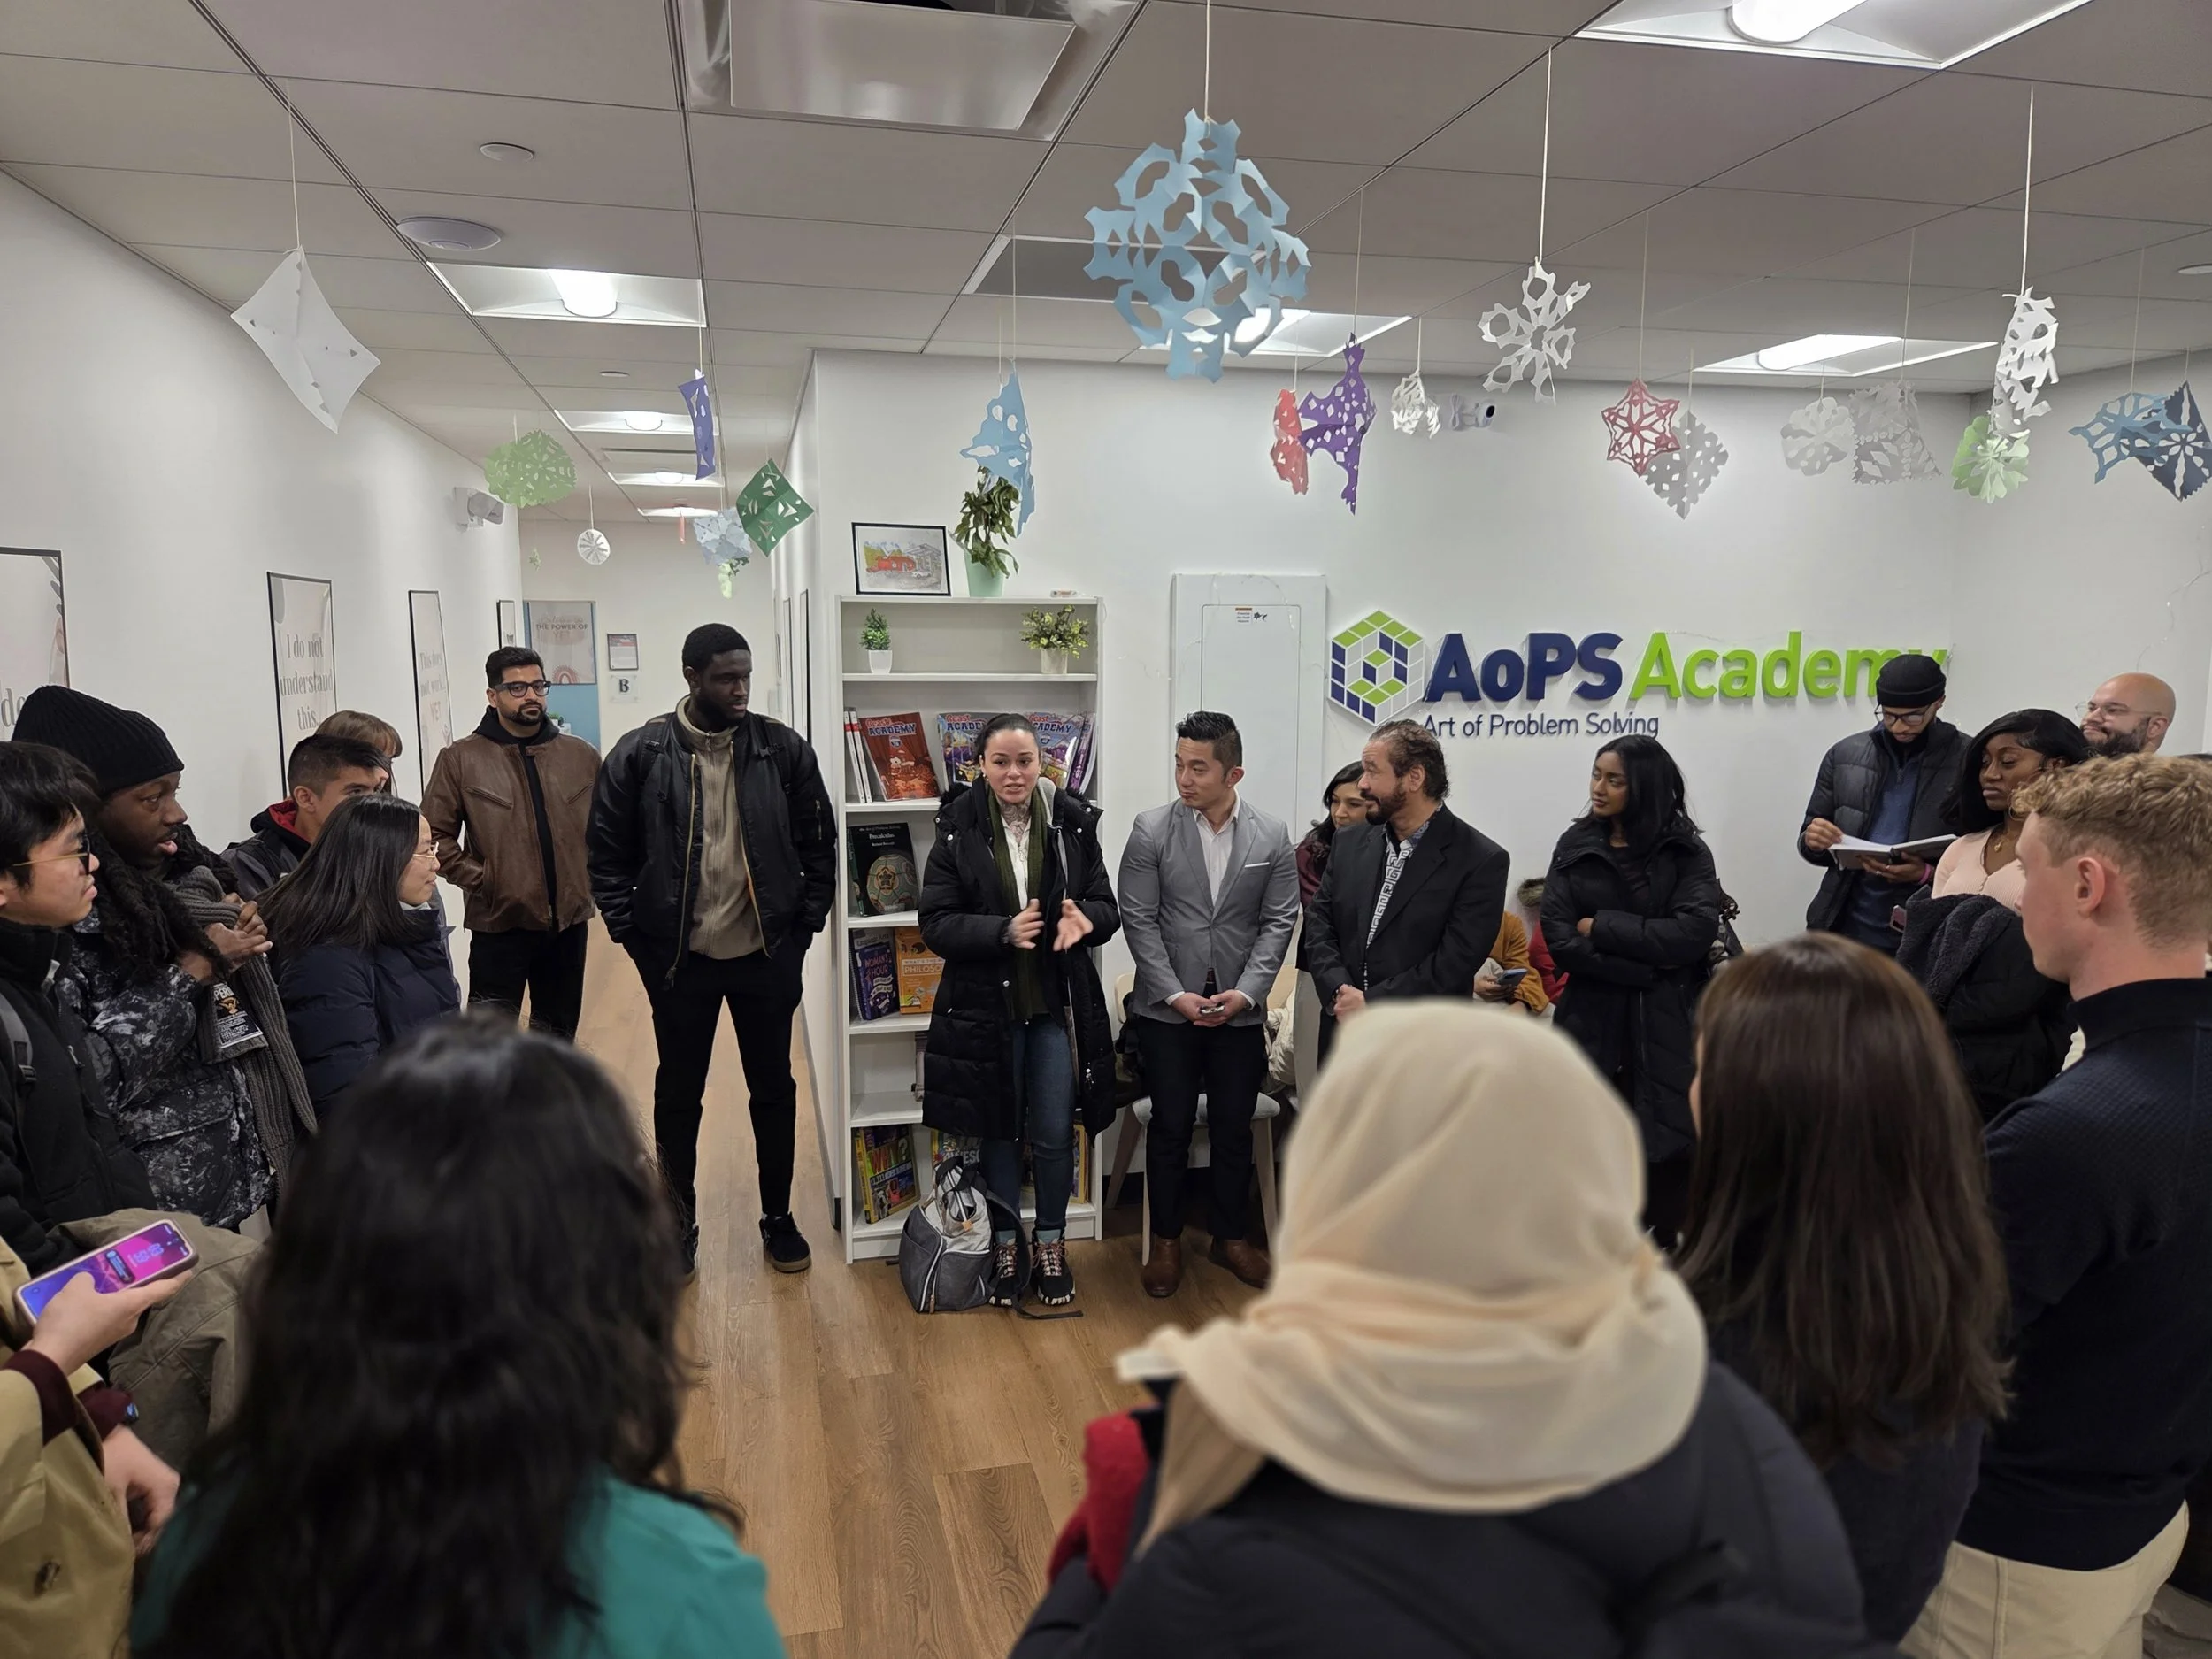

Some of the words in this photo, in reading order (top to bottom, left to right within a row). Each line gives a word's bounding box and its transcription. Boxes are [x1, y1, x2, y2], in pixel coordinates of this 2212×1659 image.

[293, 634, 304, 659] do
[308, 635, 324, 658] not
[1422, 632, 1623, 702] AoPS
[1628, 630, 1947, 699] Academ
[280, 669, 334, 696] understand
[619, 678, 629, 693] B
[869, 724, 916, 736] ACADEMY
[1423, 714, 1455, 737] Art
[1463, 714, 1484, 736] of
[1489, 713, 1578, 737] Problem
[1586, 710, 1659, 740] Solving
